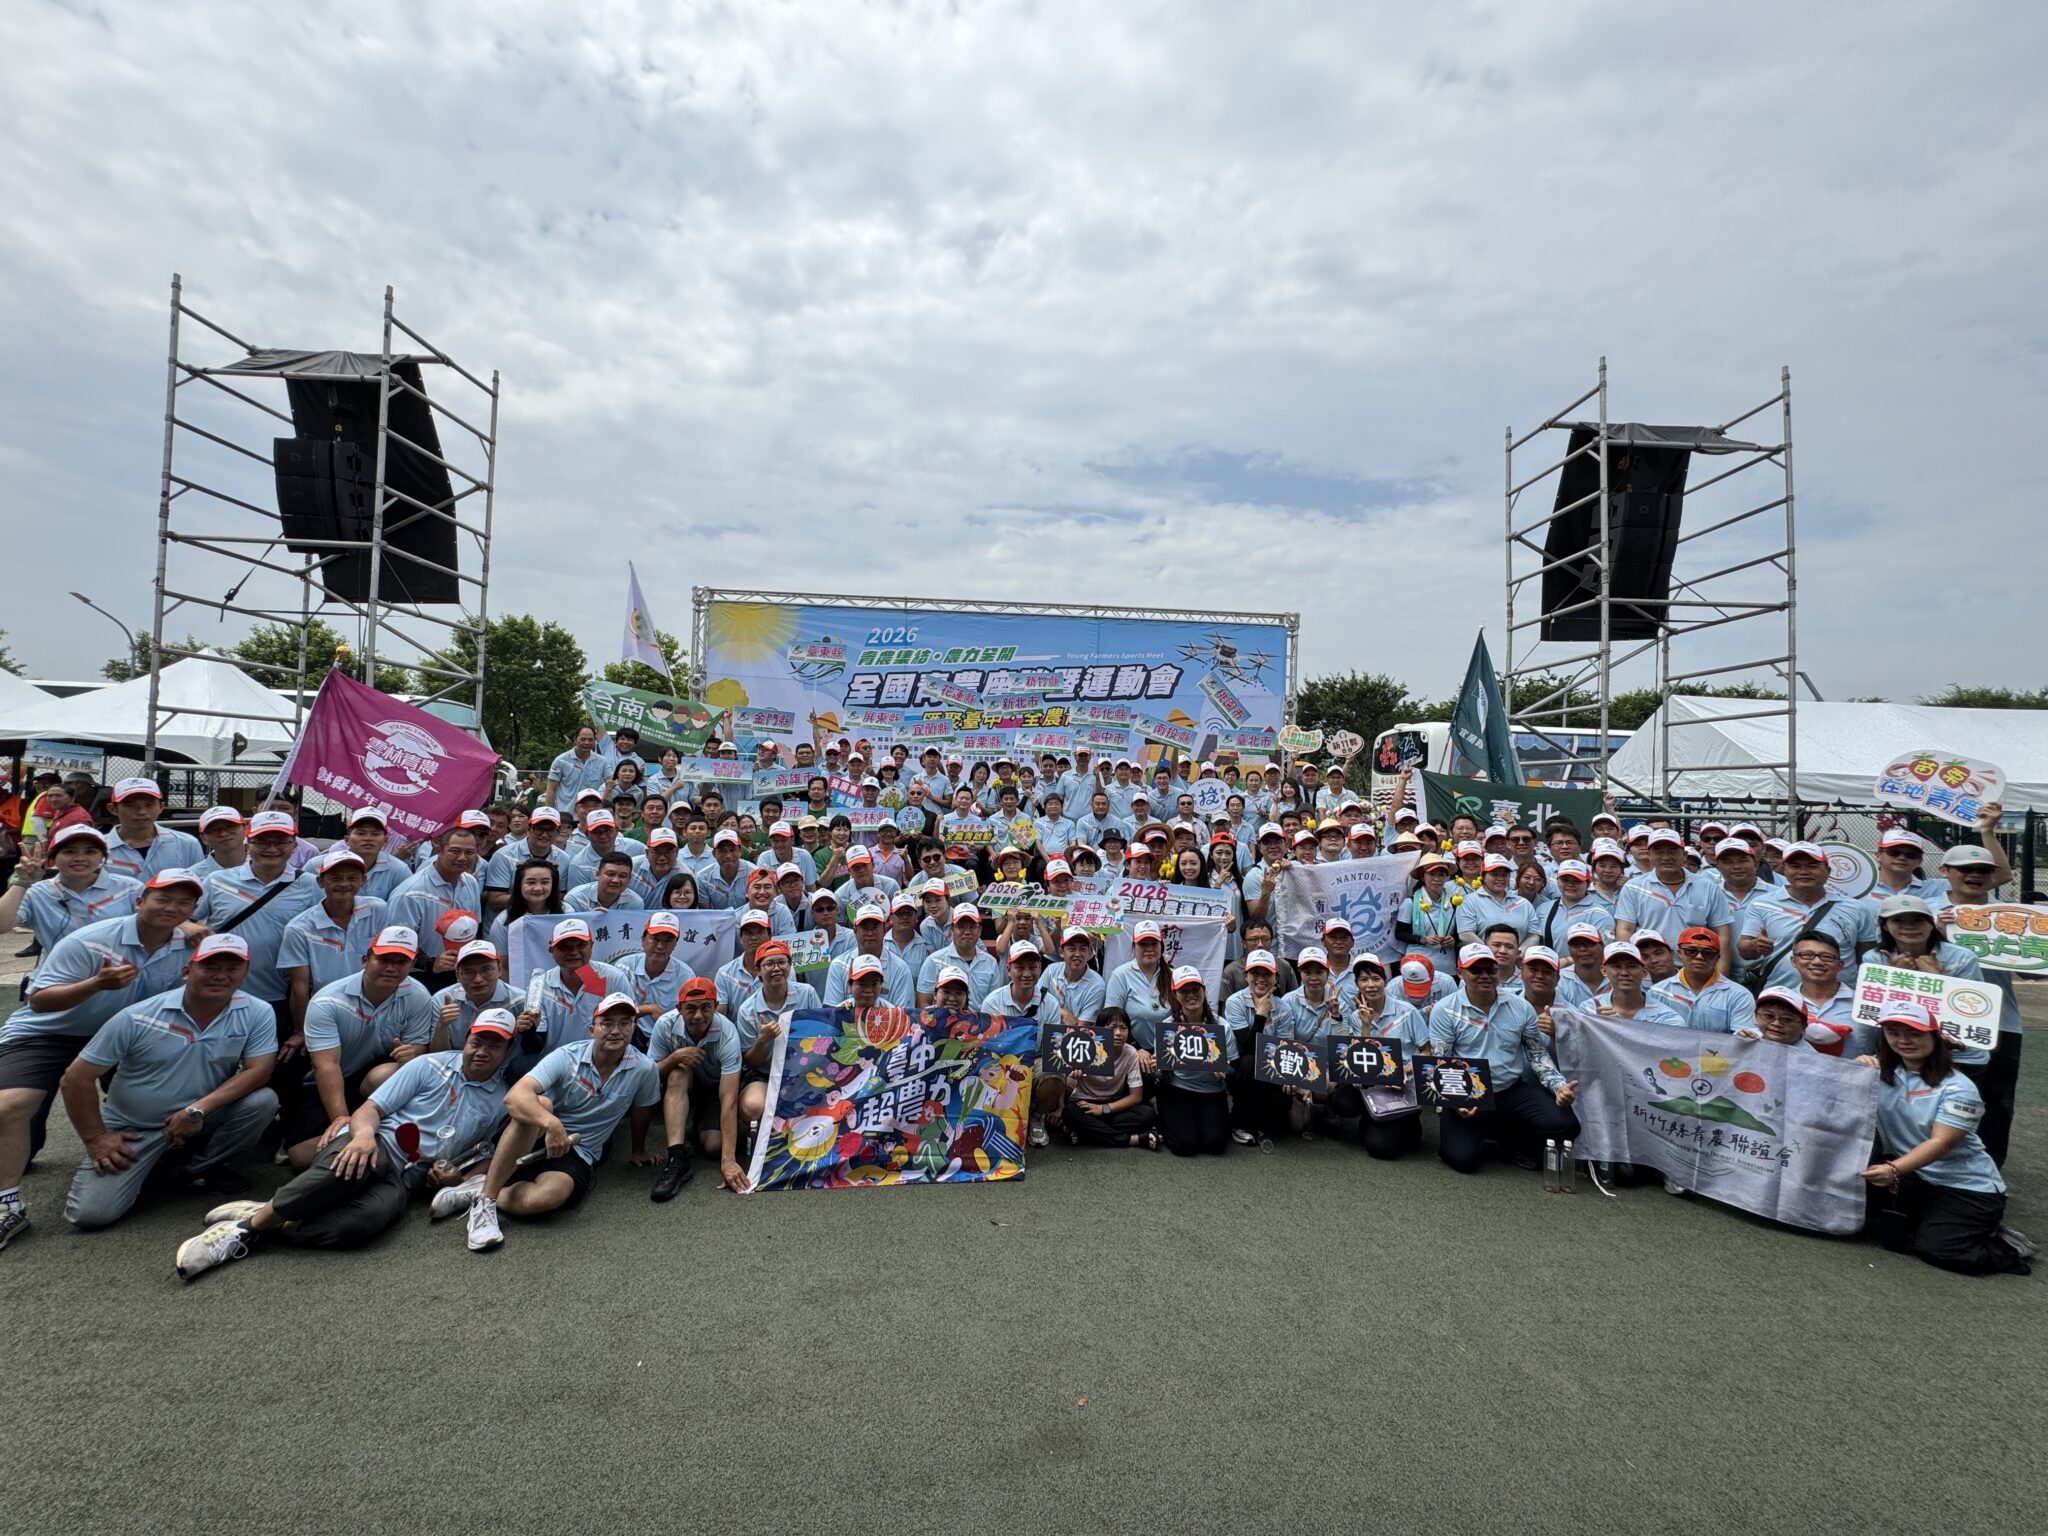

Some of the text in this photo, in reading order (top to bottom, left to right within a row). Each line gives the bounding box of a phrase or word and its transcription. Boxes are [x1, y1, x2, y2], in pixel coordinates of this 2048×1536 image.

[868, 627, 919, 644] 2026
[1121, 652, 1144, 660] Sports
[1002, 696, 1038, 709] 新北市
[1215, 689, 1246, 721] 桃園市
[753, 711, 790, 728] 金門縣
[863, 711, 900, 724] 屏東縣
[1089, 706, 1126, 721] 彰化縣
[912, 721, 949, 736] 宜蘭縣
[1088, 730, 1124, 744] 臺中市
[1154, 722, 1191, 744] 南投縣
[964, 736, 1001, 749] 苗栗縣
[1033, 733, 1068, 747] 嘉義縣
[1236, 733, 1271, 748] 臺北市
[365, 737, 439, 776] 雲林青農
[775, 770, 815, 787] 高雄市
[1914, 760, 1966, 787] 苗栗
[375, 774, 409, 791] YUNLIN
[831, 778, 859, 795] 我屏東
[1879, 778, 1981, 823] 在地青農
[850, 811, 888, 824] 雲林縣
[1489, 800, 1560, 833] 臺北
[1336, 873, 1376, 885] NANTOU
[989, 884, 1019, 894] 2026
[1119, 882, 1168, 900] 2026
[1072, 900, 1101, 912] 臺中
[1069, 913, 1113, 926] 超農力
[1863, 967, 1944, 994] 農業部
[1857, 1004, 1992, 1046] 農良場
[1066, 1036, 1091, 1063] 你
[1179, 1034, 1203, 1060] 迎
[885, 1038, 935, 1083] 臺中
[1279, 1049, 1304, 1078] 歡
[1353, 1047, 1378, 1073] 中
[1438, 1068, 1468, 1096] 臺
[863, 1075, 951, 1127] 超農力
[1633, 1104, 1793, 1167] 新竹縣青農聯誼會
